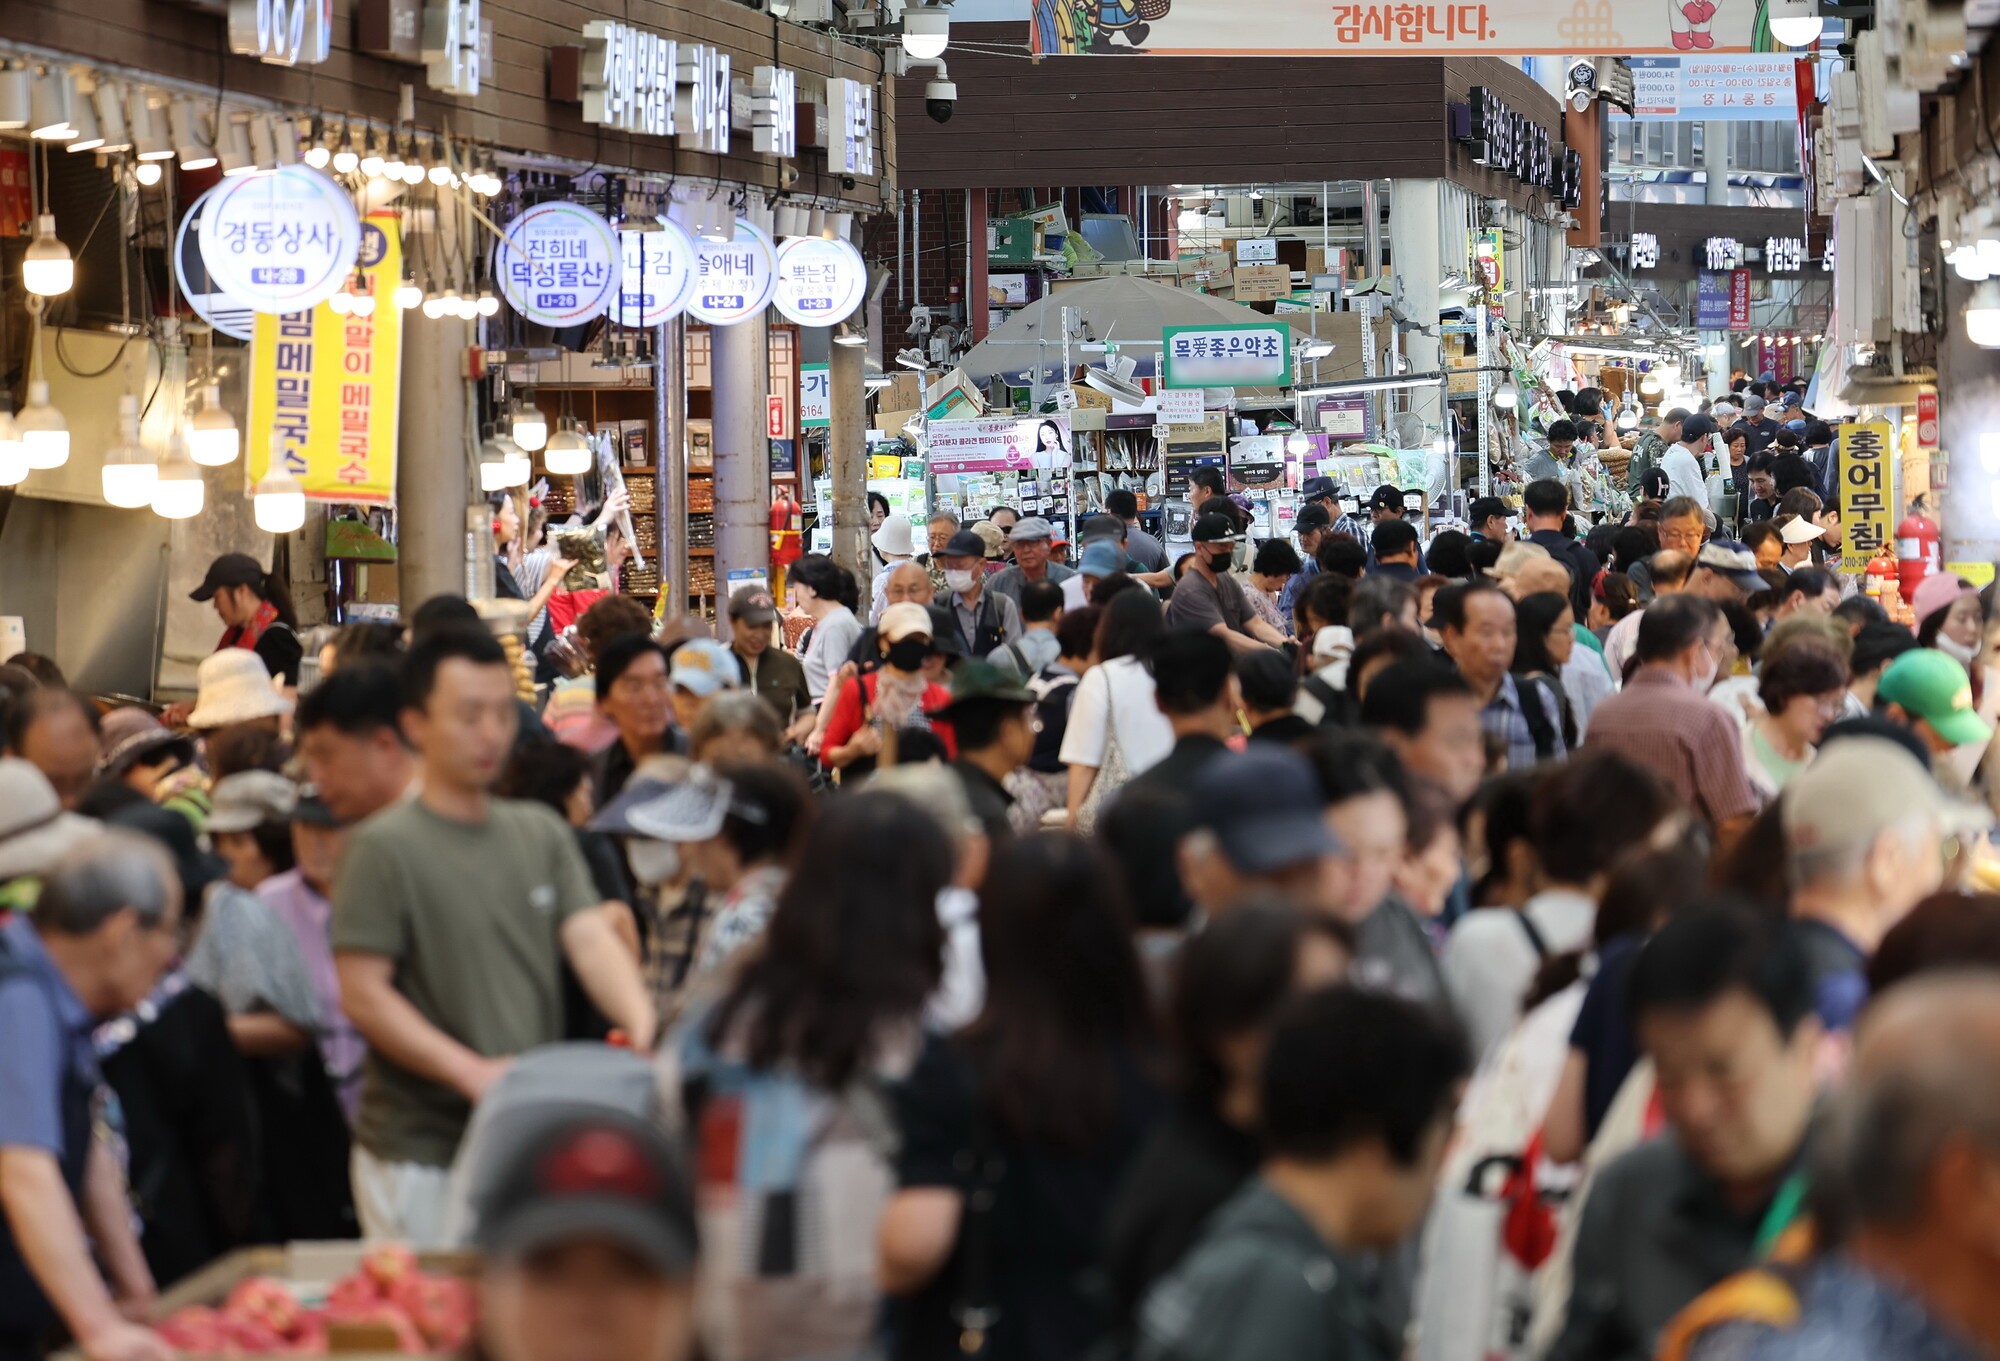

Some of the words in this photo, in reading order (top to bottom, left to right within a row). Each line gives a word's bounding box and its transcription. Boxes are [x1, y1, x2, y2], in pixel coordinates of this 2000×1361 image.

[1332, 3, 1496, 43] 감사합니다.
[223, 221, 336, 254] 경동상사
[528, 239, 588, 260] 진희네
[622, 250, 673, 276] 나김
[699, 253, 754, 277] 슬애네
[1766, 236, 1800, 273] 충남인삼
[512, 262, 604, 288] 덕성물산
[541, 294, 575, 307] 나-26
[708, 296, 738, 308] 나-24
[803, 298, 828, 309] 나-23
[959, 437, 977, 446] 콜라겐
[979, 435, 1002, 445] 펩타이드
[1846, 430, 1885, 551] 홍어무침
